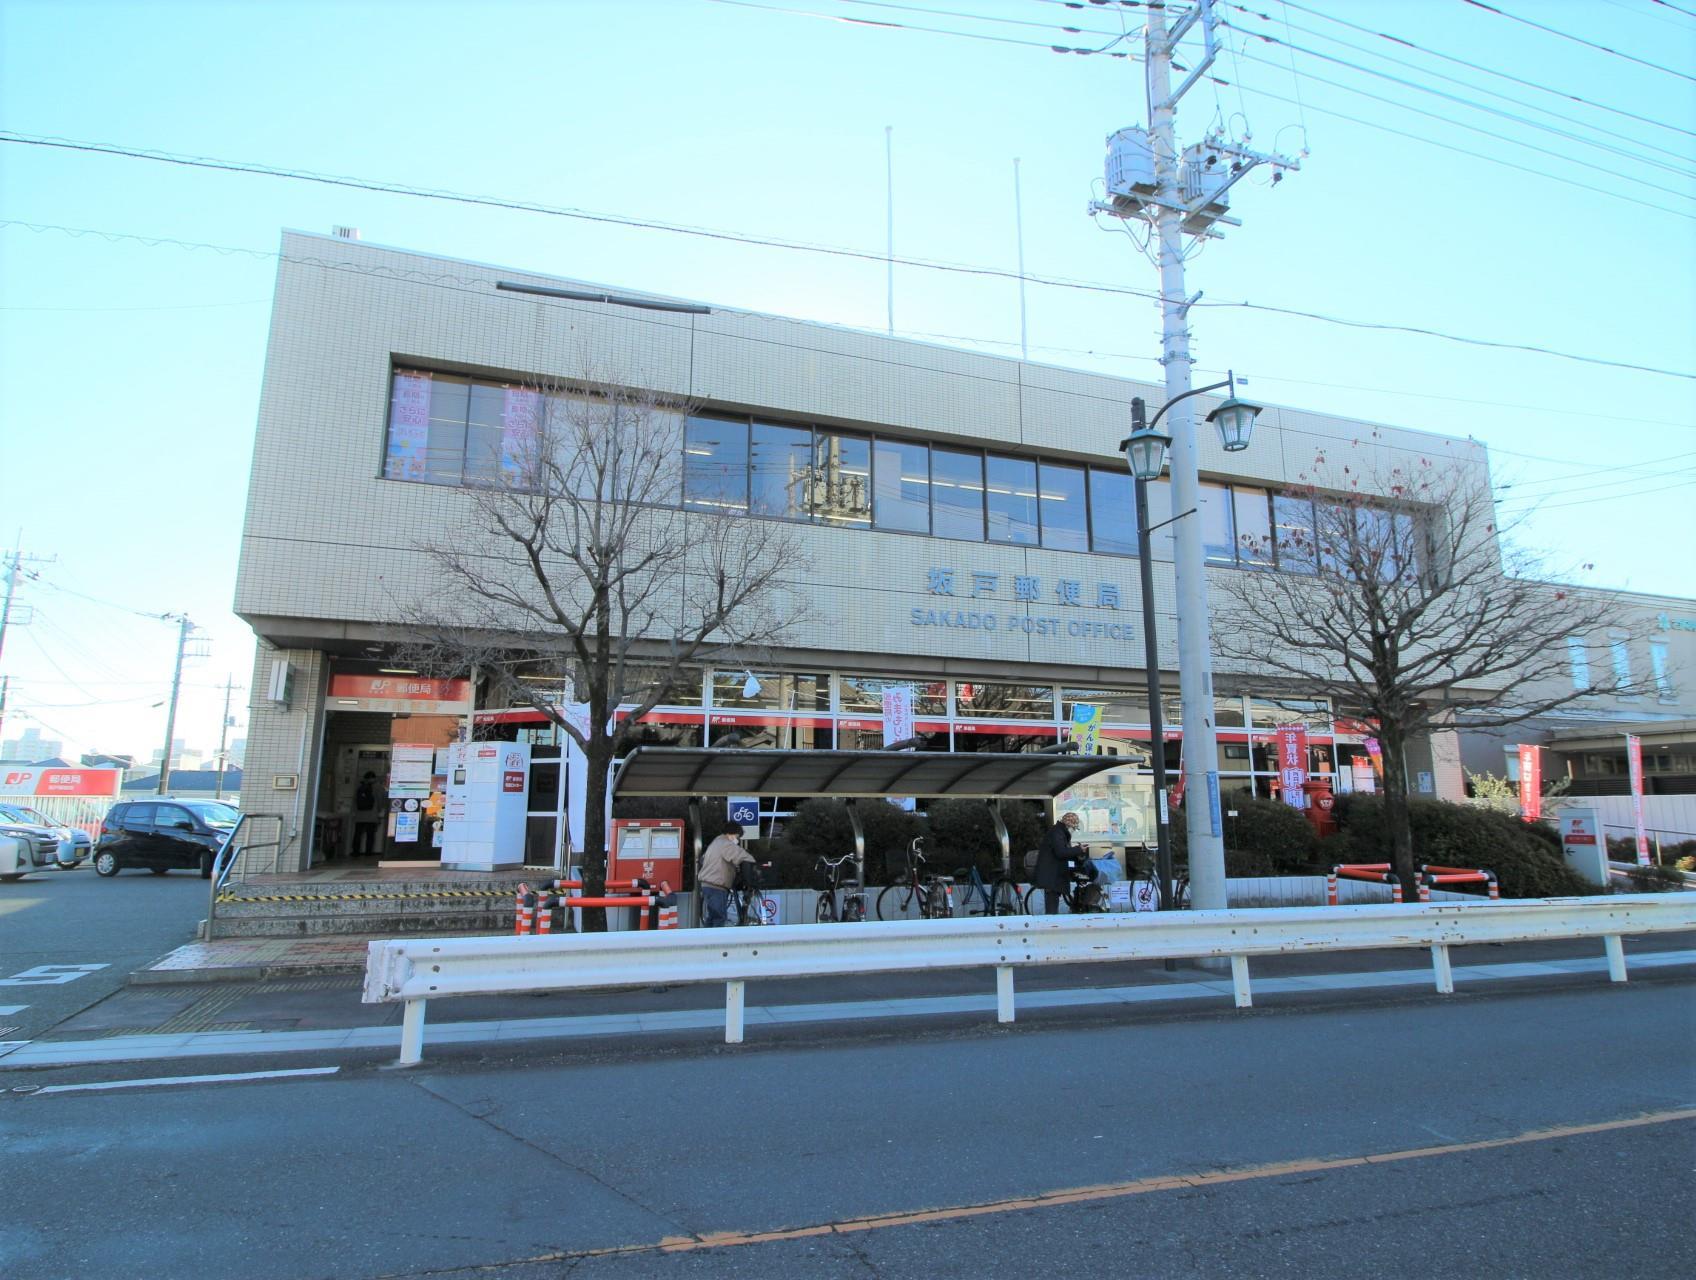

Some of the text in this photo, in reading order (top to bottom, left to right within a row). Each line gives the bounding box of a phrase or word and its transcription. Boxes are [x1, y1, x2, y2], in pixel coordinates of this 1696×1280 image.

[927, 567, 1121, 609] 坂戸郵便局
[911, 608, 1135, 641] SAKADO POST OFFICE
[396, 682, 431, 694] 郵便局
